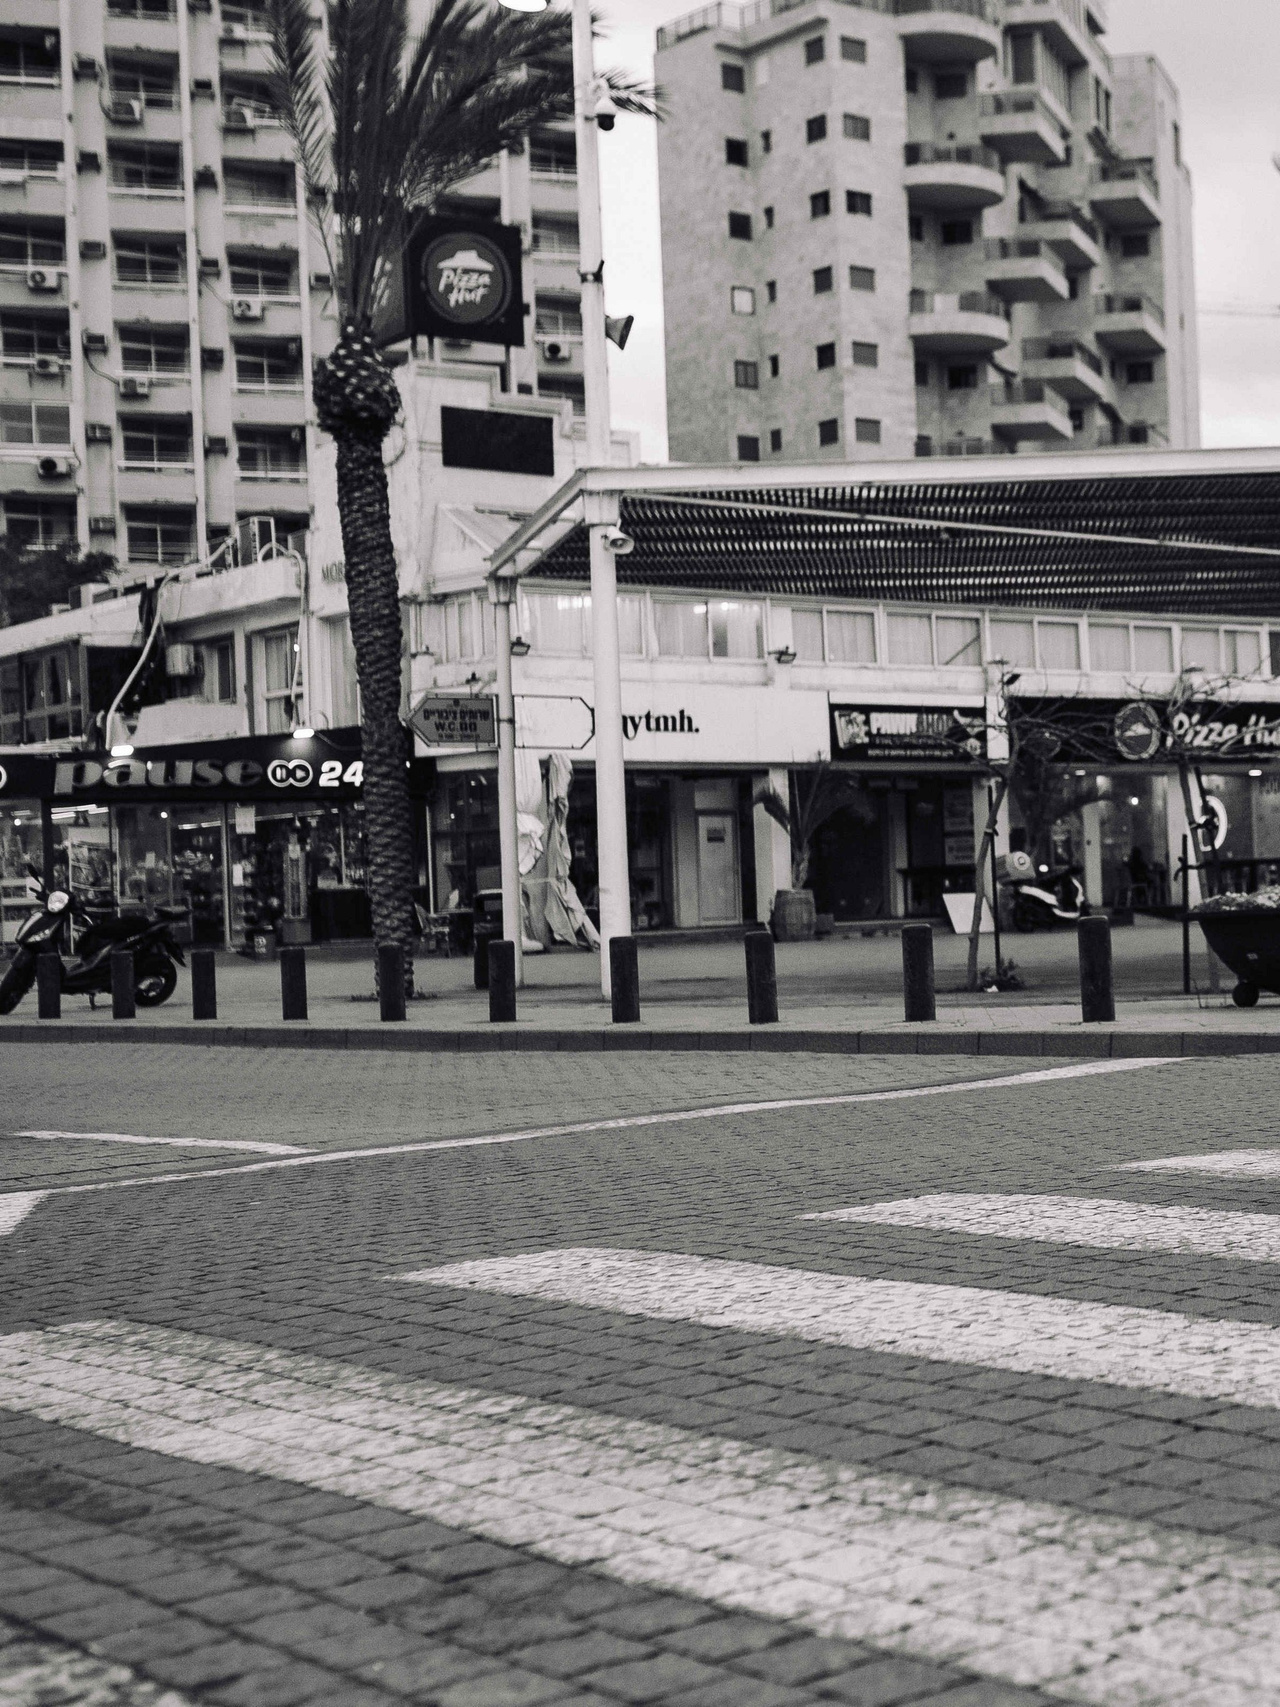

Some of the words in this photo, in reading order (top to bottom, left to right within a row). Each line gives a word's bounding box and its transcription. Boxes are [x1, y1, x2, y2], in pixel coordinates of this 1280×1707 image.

[448, 287, 489, 308] Hut
[1166, 711, 1239, 749] Pizza
[54, 759, 263, 796] pause
